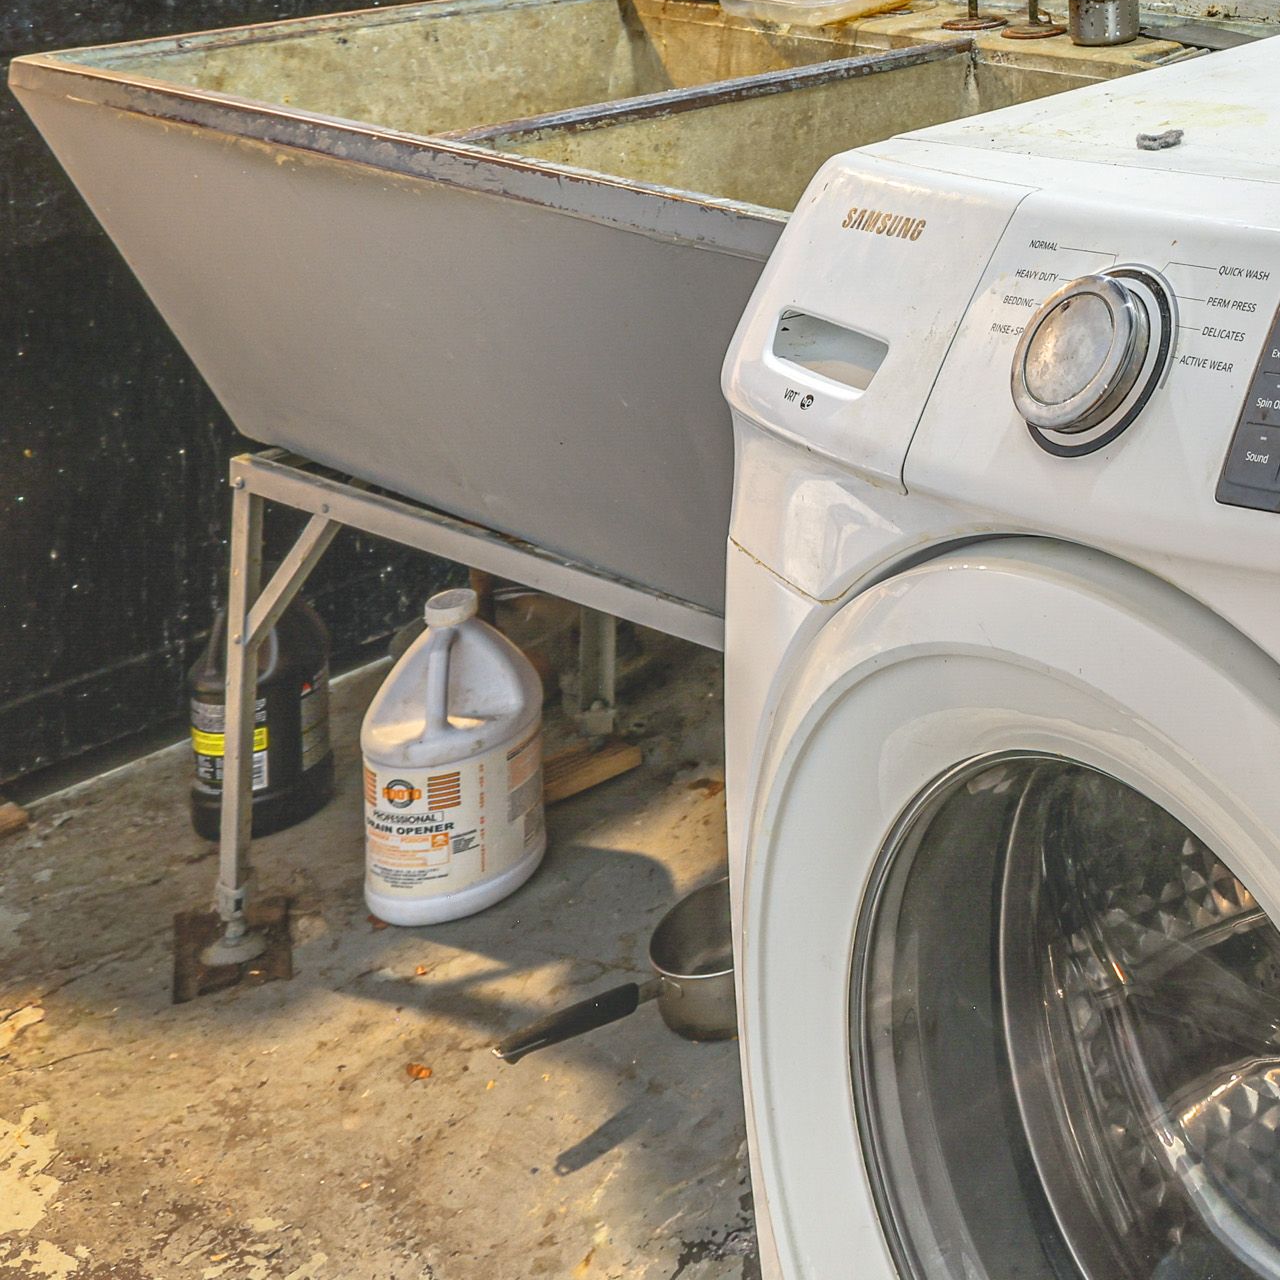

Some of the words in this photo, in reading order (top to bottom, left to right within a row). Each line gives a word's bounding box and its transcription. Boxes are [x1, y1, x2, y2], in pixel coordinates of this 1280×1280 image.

[842, 207, 926, 241] SAMSUNG
[1028, 239, 1058, 252] NORMAL
[1014, 268, 1038, 280] HEAVY
[1038, 271, 1059, 283] DUTY
[1218, 265, 1244, 278] QUICK
[1245, 268, 1271, 281] WASH
[1002, 295, 1034, 309] BEDDING
[1206, 296, 1230, 310] PERM
[1231, 300, 1258, 313] PRESS
[990, 322, 1024, 336] RINSE+SP
[1202, 326, 1246, 342] DELICATES
[1179, 355, 1208, 369] ACTIVE
[1208, 360, 1234, 373] WEAR
[1256, 397, 1273, 409] Spin
[1245, 452, 1269, 464] Sound
[396, 821, 455, 835] OPENER
